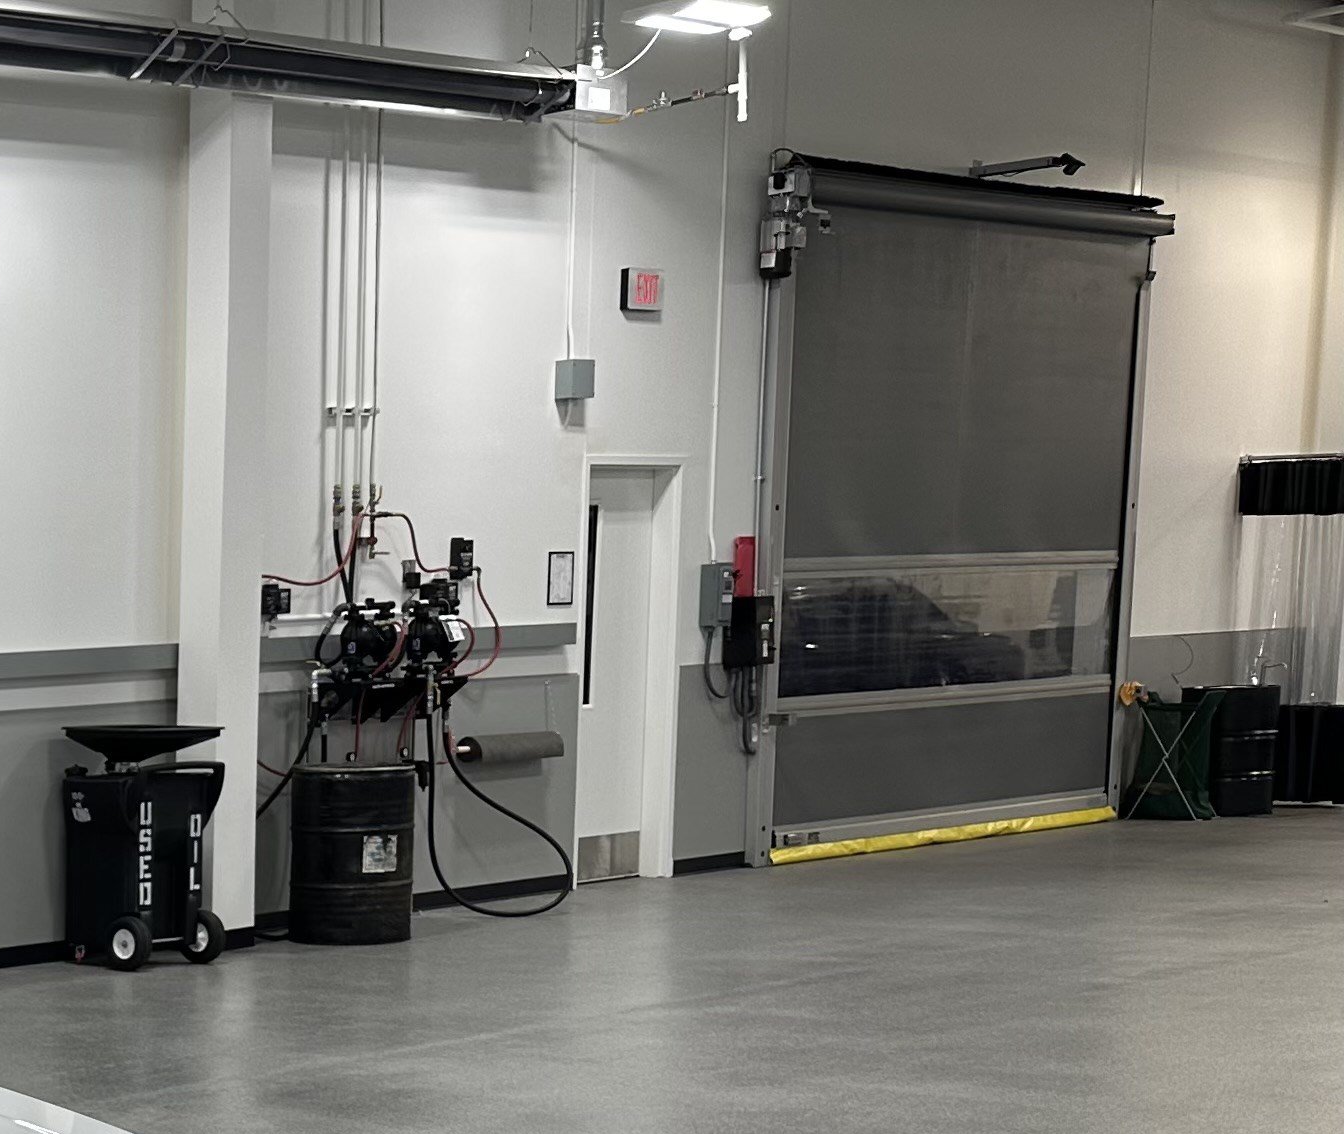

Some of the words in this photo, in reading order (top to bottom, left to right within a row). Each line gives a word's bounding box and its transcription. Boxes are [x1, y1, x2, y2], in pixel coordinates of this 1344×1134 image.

[636, 272, 659, 304] EXIT
[139, 801, 152, 906] USED
[189, 813, 201, 891] OIL
